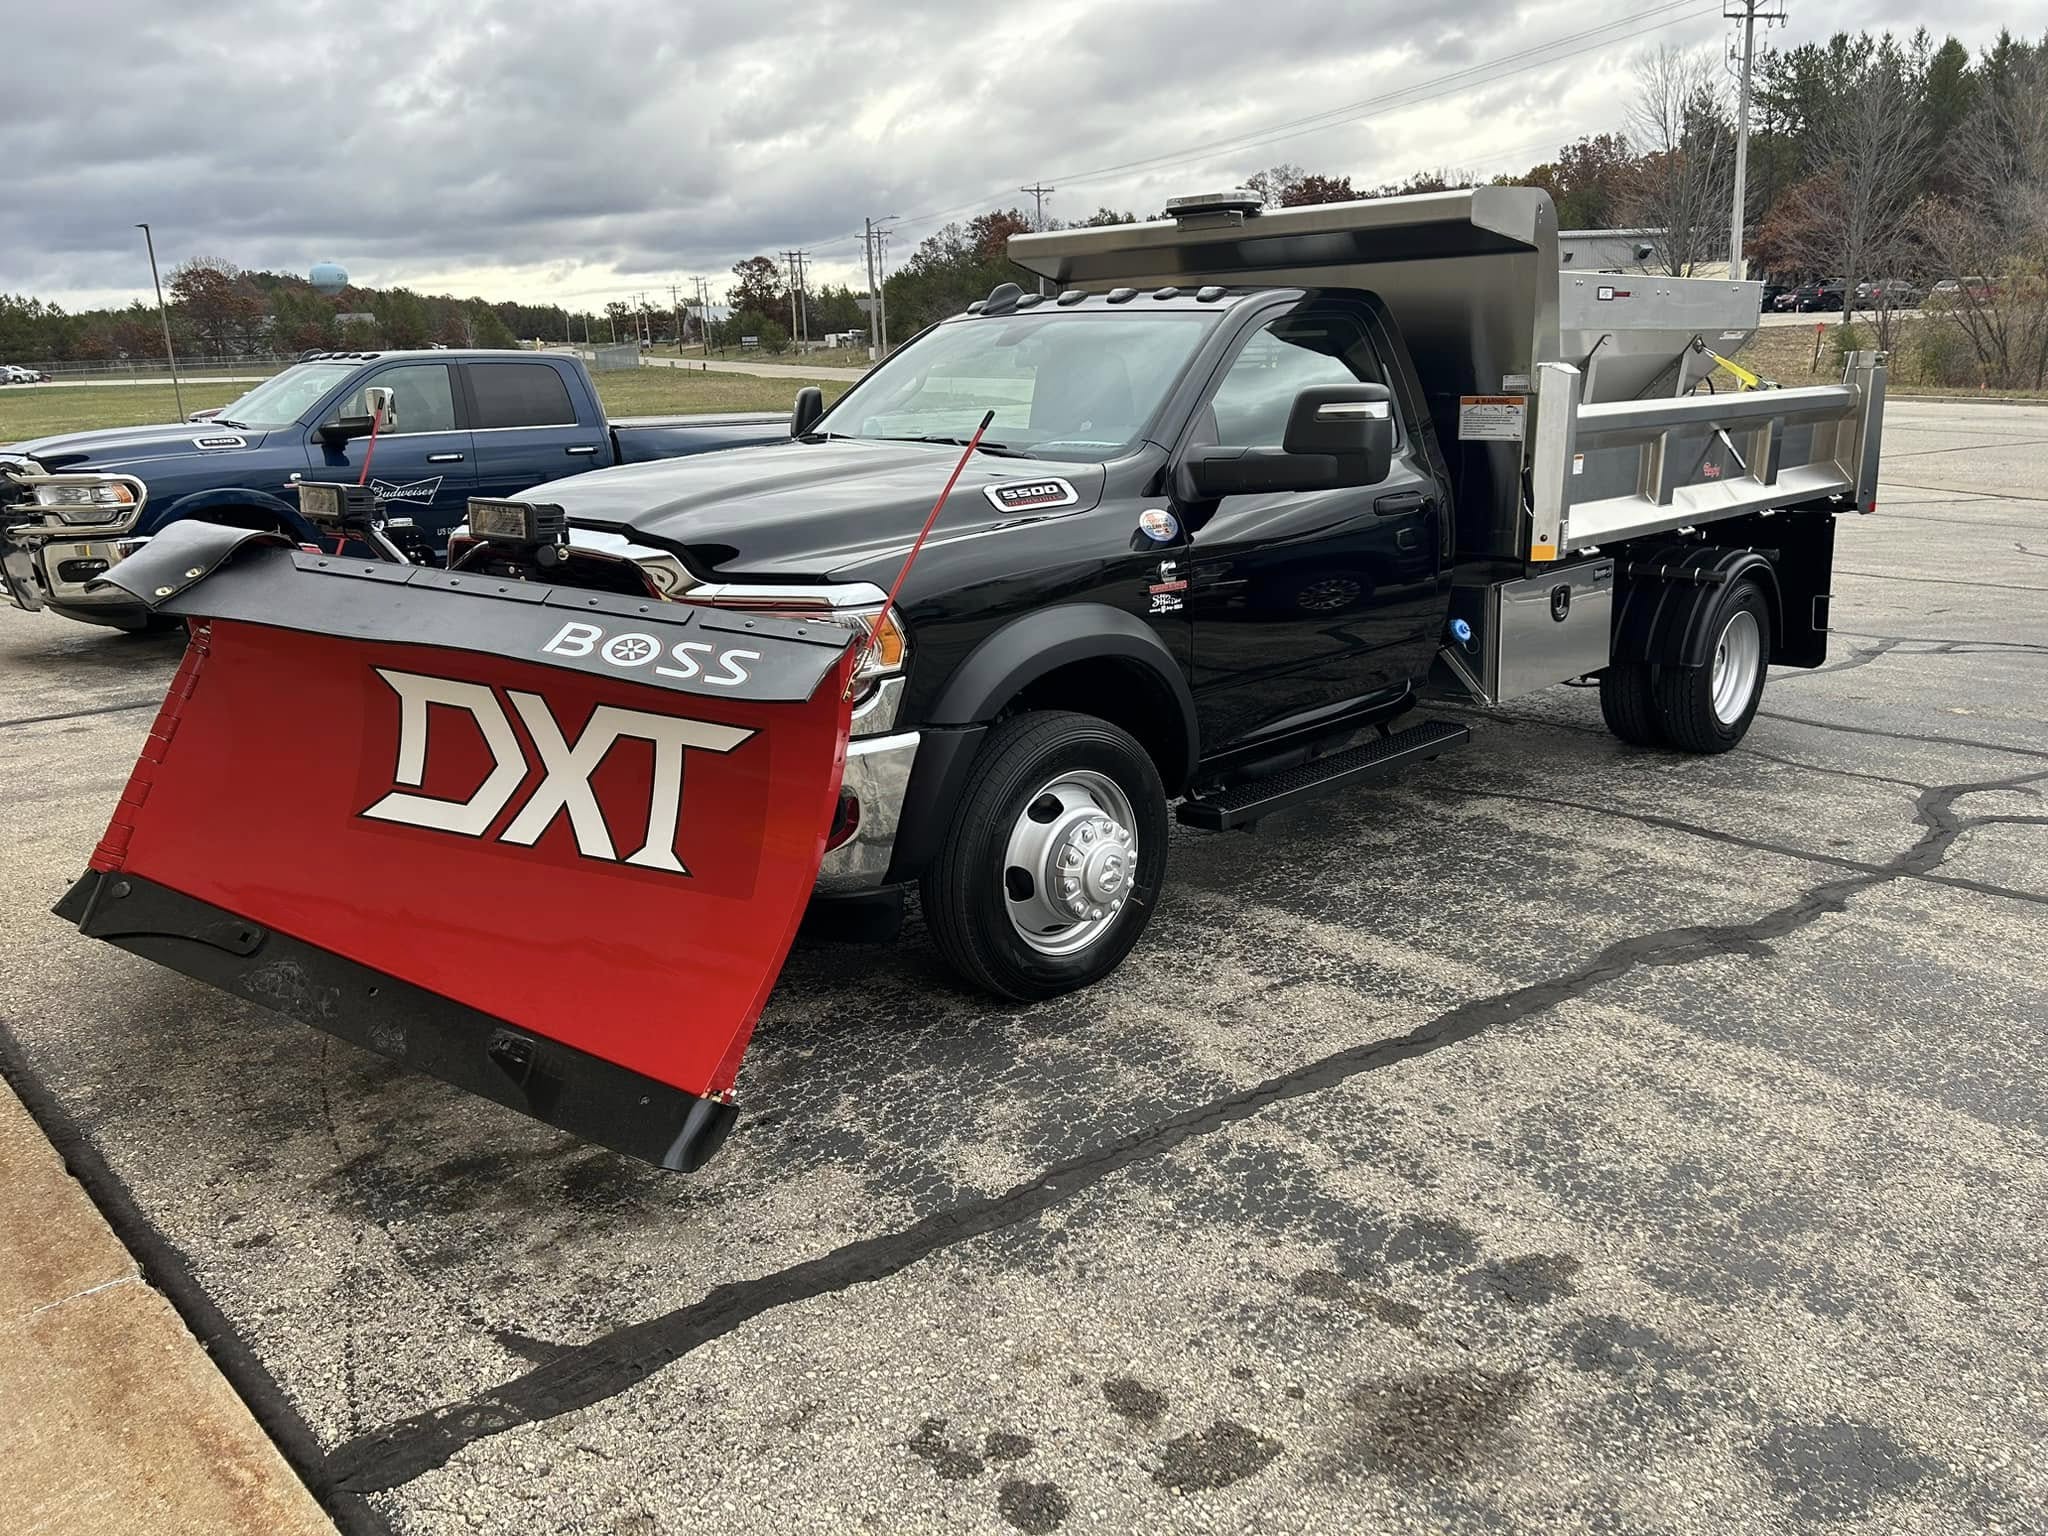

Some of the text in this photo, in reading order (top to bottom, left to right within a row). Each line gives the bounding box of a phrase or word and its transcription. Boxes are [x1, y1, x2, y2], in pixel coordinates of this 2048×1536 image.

[373, 486, 435, 498] Budweiser
[1002, 484, 1058, 499] 5500
[437, 528, 446, 536] US
[543, 621, 760, 686] BOSS
[357, 666, 760, 876] DXT
